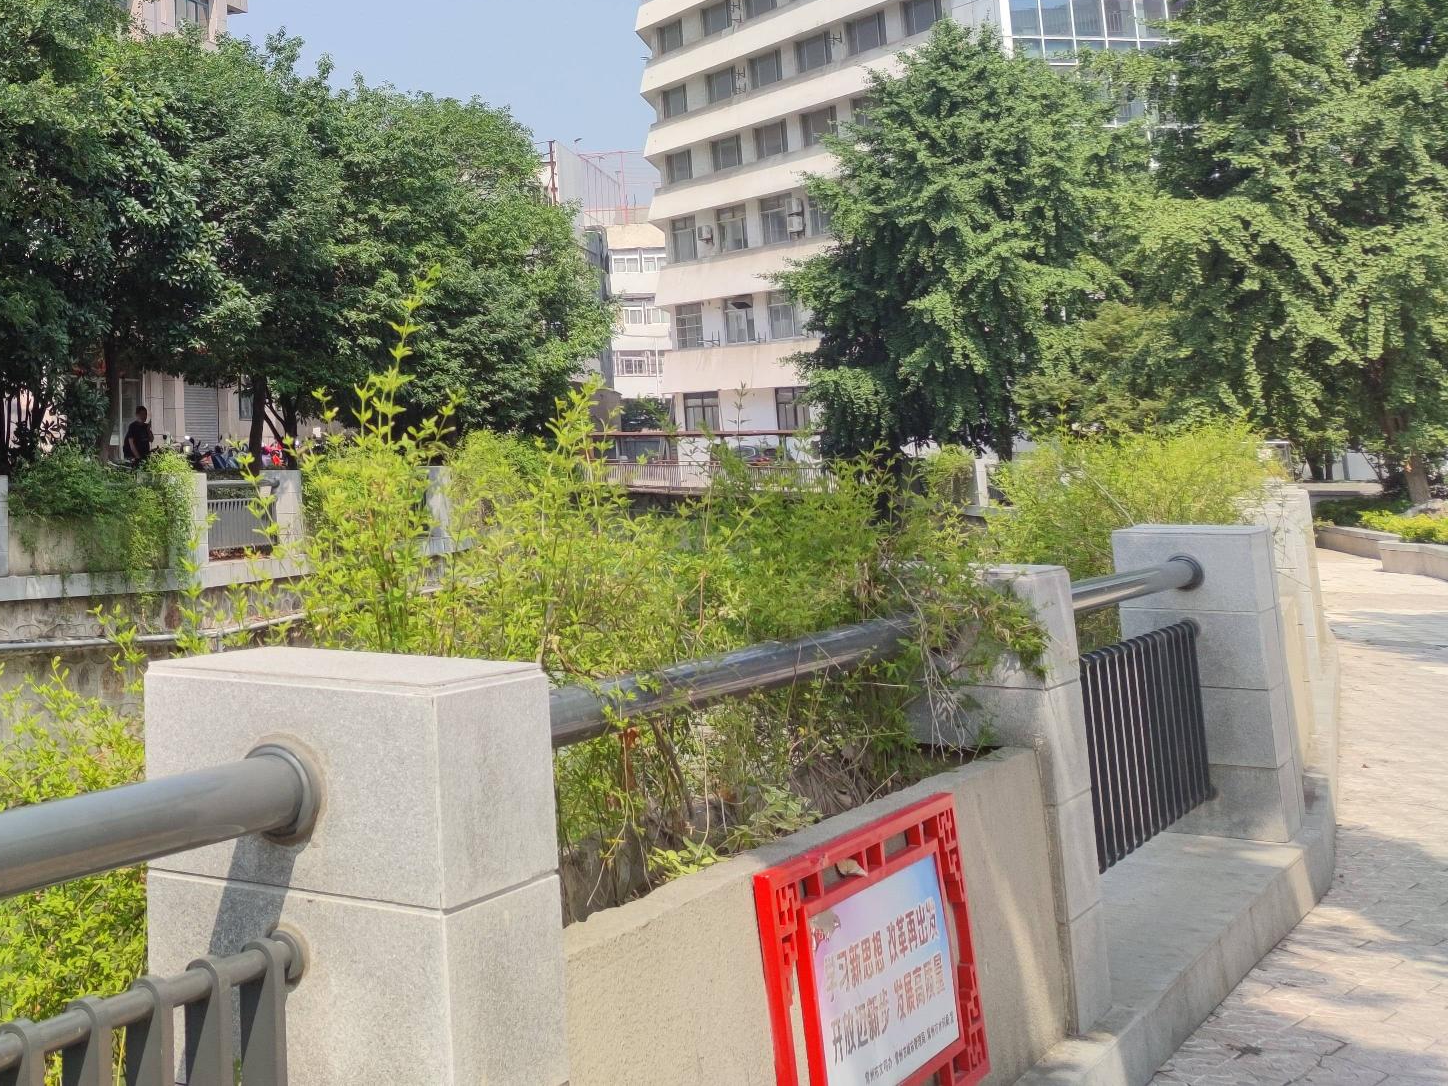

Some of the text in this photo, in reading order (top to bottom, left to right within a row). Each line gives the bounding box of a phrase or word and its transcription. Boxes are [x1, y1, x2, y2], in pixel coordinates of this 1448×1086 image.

[824, 897, 939, 1002] 学习新思想 改革再出发
[894, 952, 945, 1020] 发展高质量
